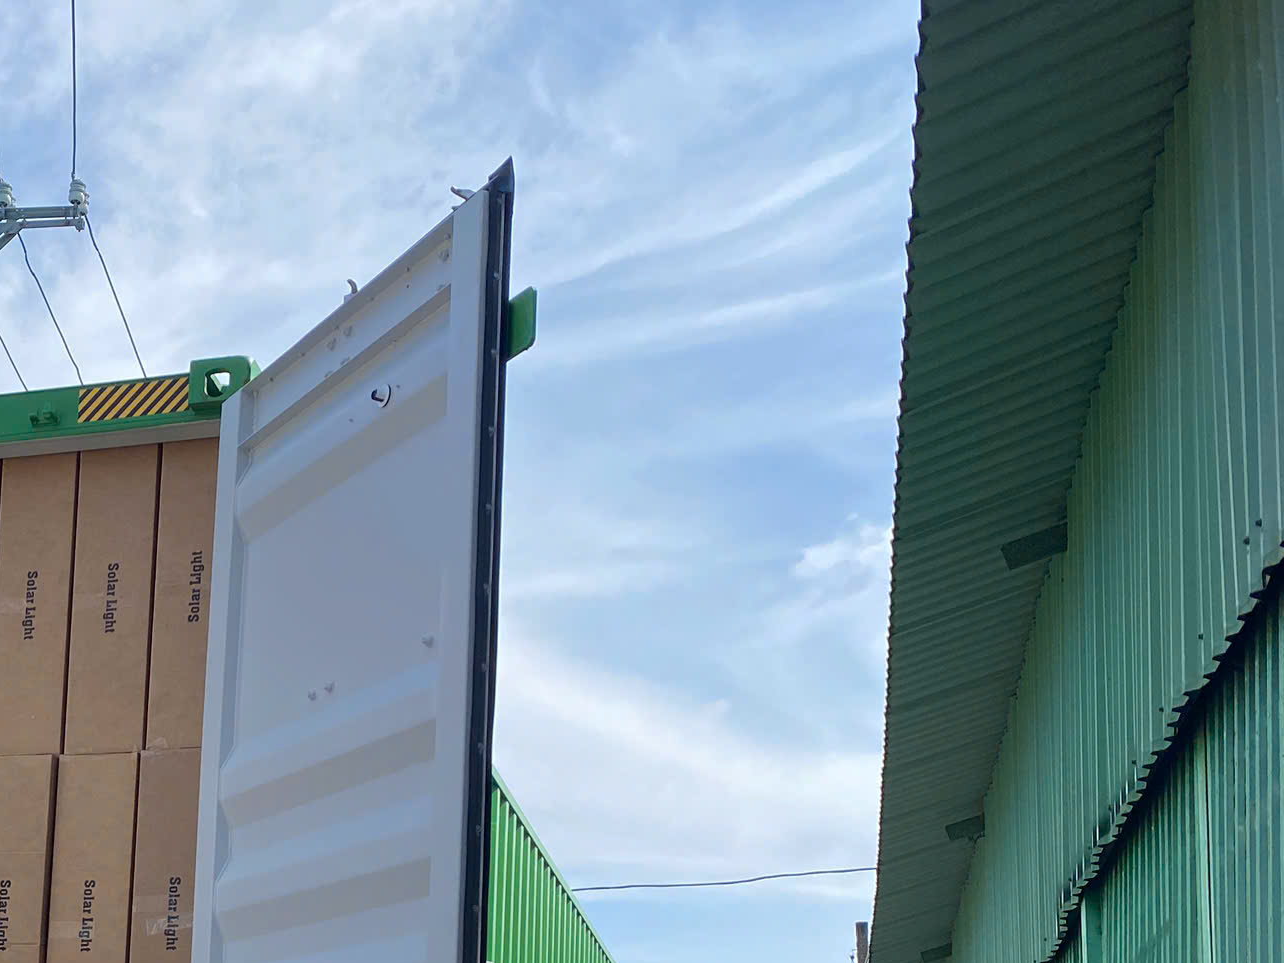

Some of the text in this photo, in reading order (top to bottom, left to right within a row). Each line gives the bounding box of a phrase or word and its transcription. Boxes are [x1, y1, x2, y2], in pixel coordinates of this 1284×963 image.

[21, 570, 39, 641] Solar Light
[102, 562, 120, 634] Solar Light
[187, 550, 205, 623] Solar Light
[78, 879, 96, 953] Solar Light
[163, 876, 182, 951] Solar Light
